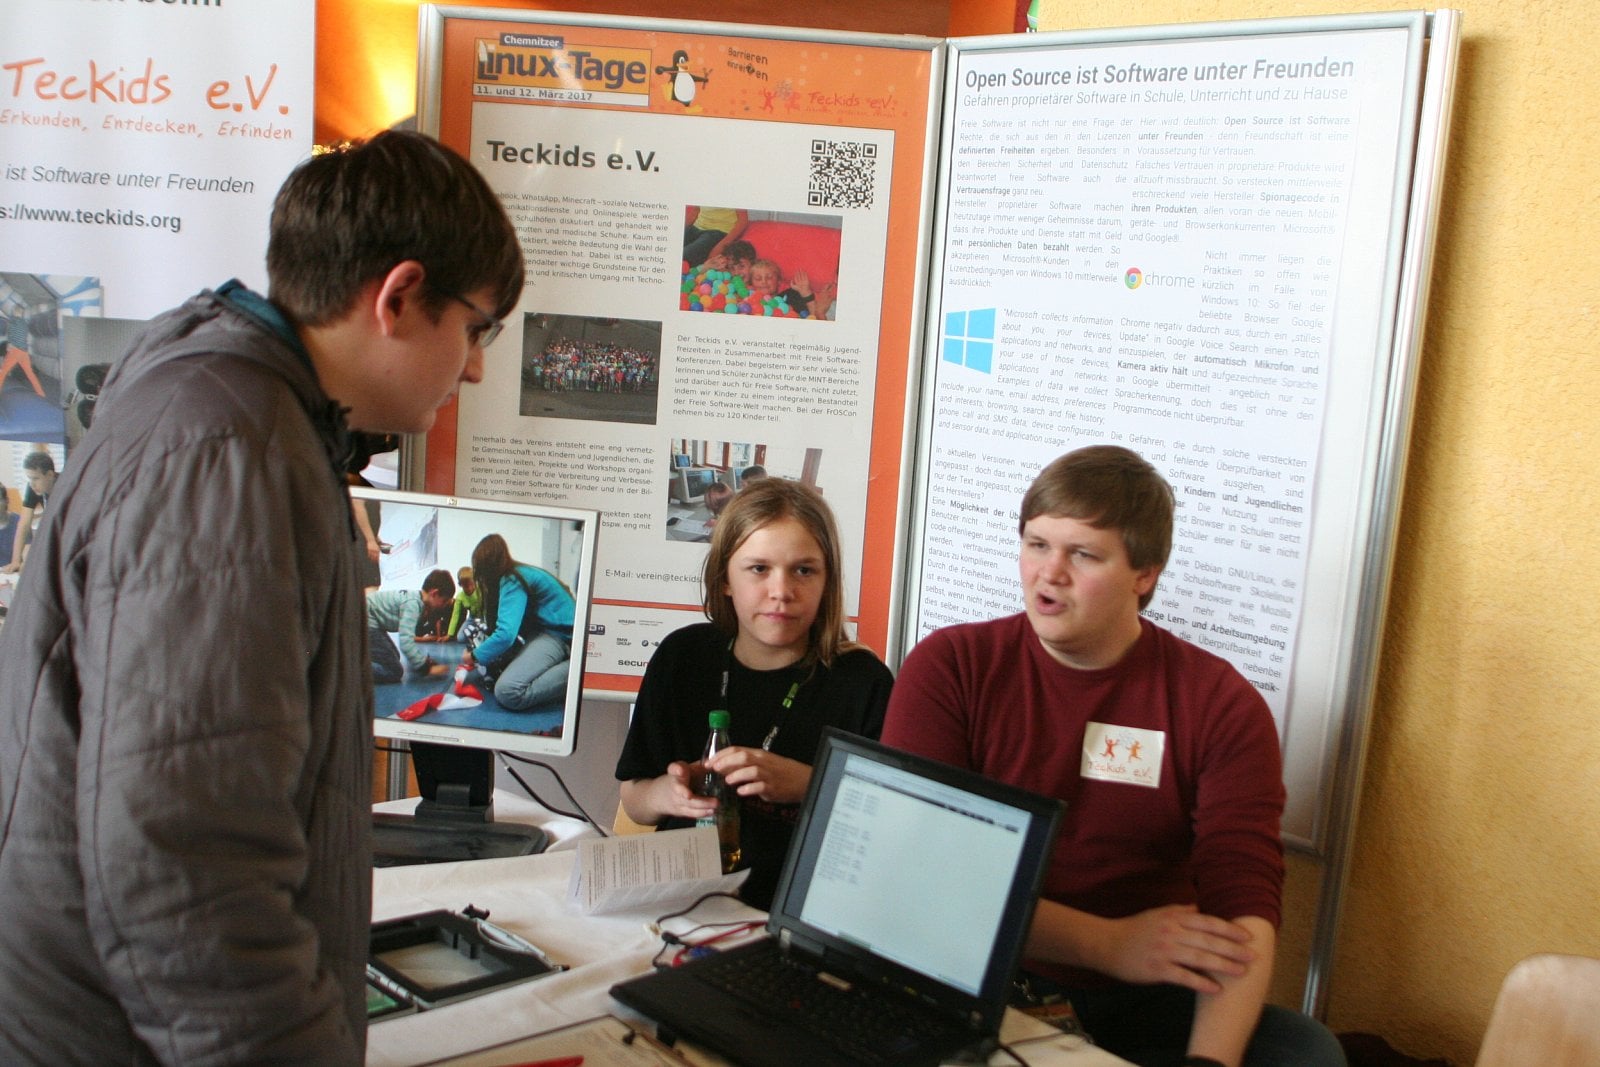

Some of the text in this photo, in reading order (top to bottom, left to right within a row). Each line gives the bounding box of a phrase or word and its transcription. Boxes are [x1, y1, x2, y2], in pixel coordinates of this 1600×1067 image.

[504, 35, 560, 47] Chemnitzer
[728, 47, 768, 65] Barrieren
[477, 40, 646, 90] Linux-Tage
[965, 56, 1354, 92] Open Source ist Software unter Freunden
[2, 58, 289, 115] Teckids e.V.
[476, 86, 592, 101] 11. und 12. März 2017
[808, 92, 895, 111] Teckids e.V.
[964, 86, 1348, 108] Gefahren proprietärer Software in Schule, Unterricht und zu Hause
[0, 109, 292, 140] Erkunden, Entdecken, Erfinden
[982, 120, 1013, 128] Software
[1018, 119, 1026, 127] ist
[1032, 119, 1049, 127] nicht
[1093, 118, 1114, 127] Frage
[1120, 118, 1133, 126] der
[1224, 116, 1300, 126] Open Source ist
[1138, 131, 1204, 141] unter Freunden
[487, 140, 659, 172] Teckids e.V.
[959, 146, 1035, 155] definierten Freiheiten
[6, 164, 254, 194] ist Software unter Freunden
[957, 187, 1010, 195] Vertrauensfrage
[1260, 192, 1325, 204] Spionagecode
[1155, 205, 1198, 213] Produkten,
[969, 240, 1012, 249] persönlichen
[1043, 243, 1069, 251] bezahlt
[1030, 269, 1073, 280] Windows 10
[1145, 272, 1195, 288] chrome
[1166, 336, 1259, 352] Google Voice Search
[1118, 361, 1188, 376] Kamera aktiv hält
[1194, 355, 1318, 374] automatisch Mikrofon und
[673, 408, 702, 417] nehmen
[743, 413, 766, 421] Kinder
[993, 414, 1008, 423] SMS
[472, 435, 506, 443] Innerhalb
[526, 439, 552, 447] Vereins
[556, 441, 585, 449] entsteht
[626, 445, 655, 454] vernetz-
[470, 487, 569, 500] dung gemeinsam verfolgen.
[1184, 486, 1303, 513] Kindern und Jugendlichen
[950, 500, 1004, 517] Möglichkeit der
[606, 569, 633, 578] E-Mail:
[1168, 613, 1285, 650] Lern- und Arbeitsumgebung
